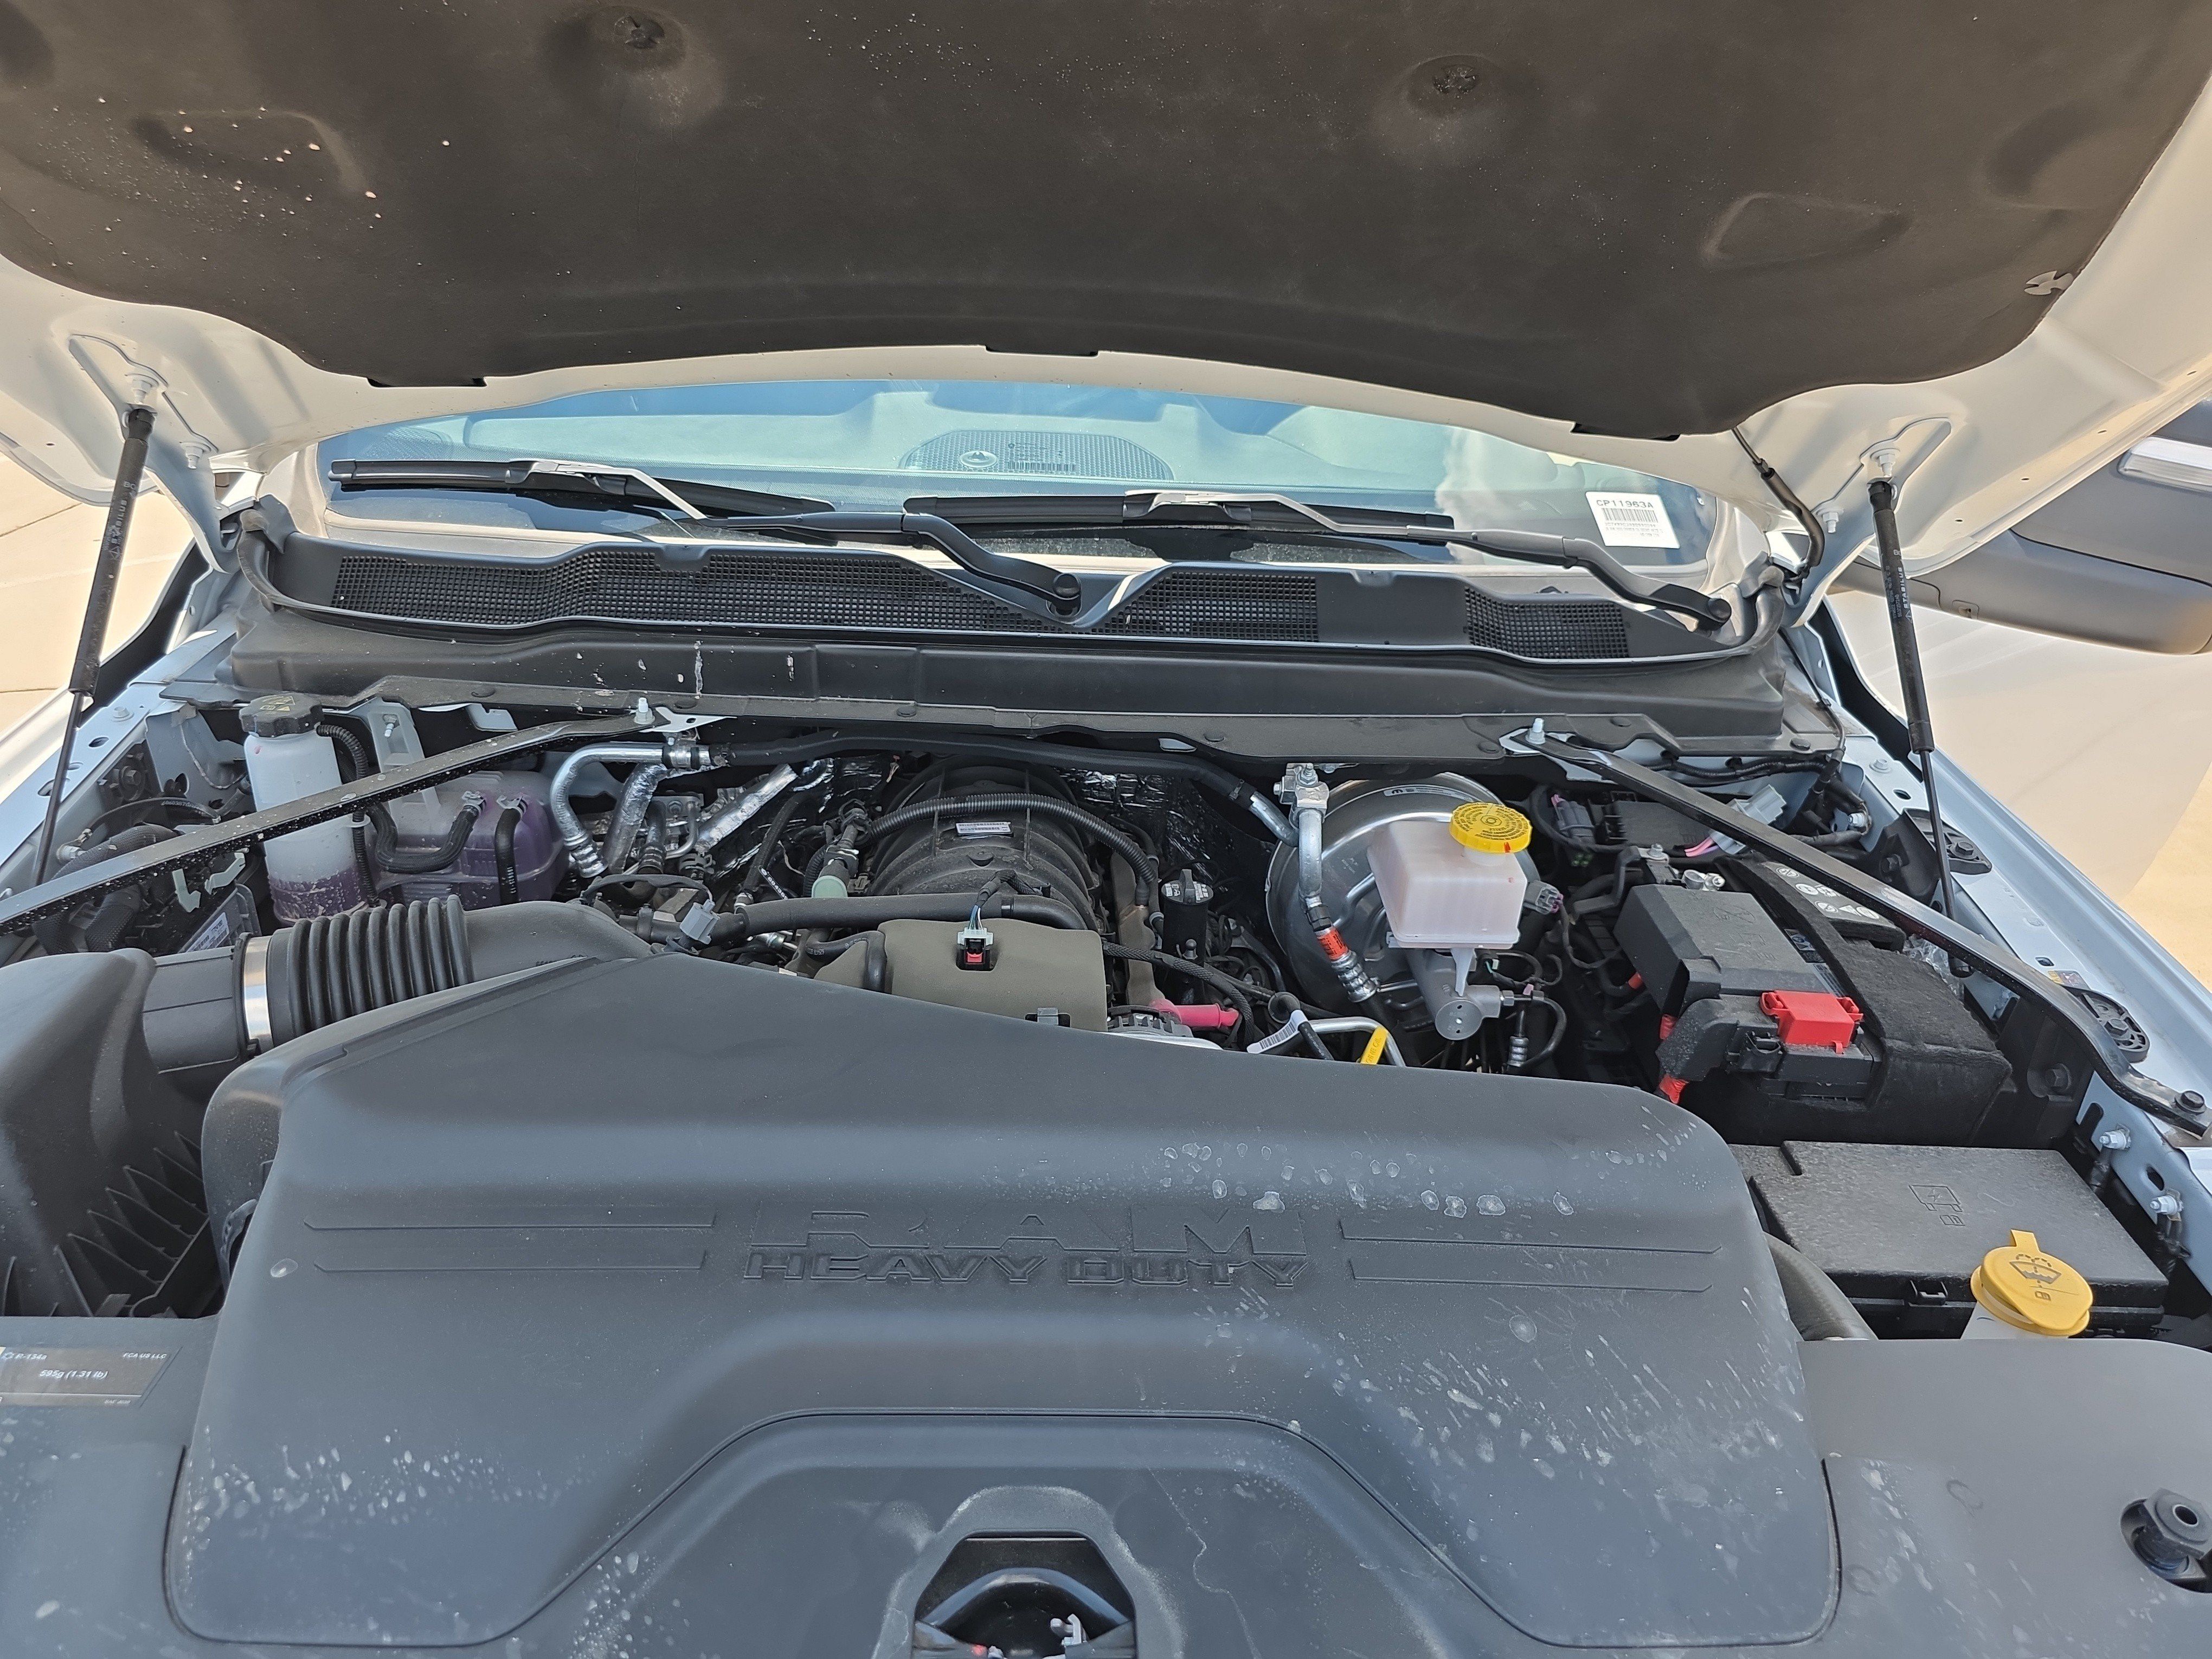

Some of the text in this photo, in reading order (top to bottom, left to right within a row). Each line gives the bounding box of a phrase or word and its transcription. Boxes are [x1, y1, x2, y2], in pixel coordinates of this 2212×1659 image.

[111, 499, 127, 544] SBILUS
[1596, 499, 1654, 509] CP11963A
[751, 1203, 1307, 1256] RAM
[743, 1251, 1310, 1288] HEAVY DUTY
[39, 1369, 108, 1379] 595g (1.31 lb)
